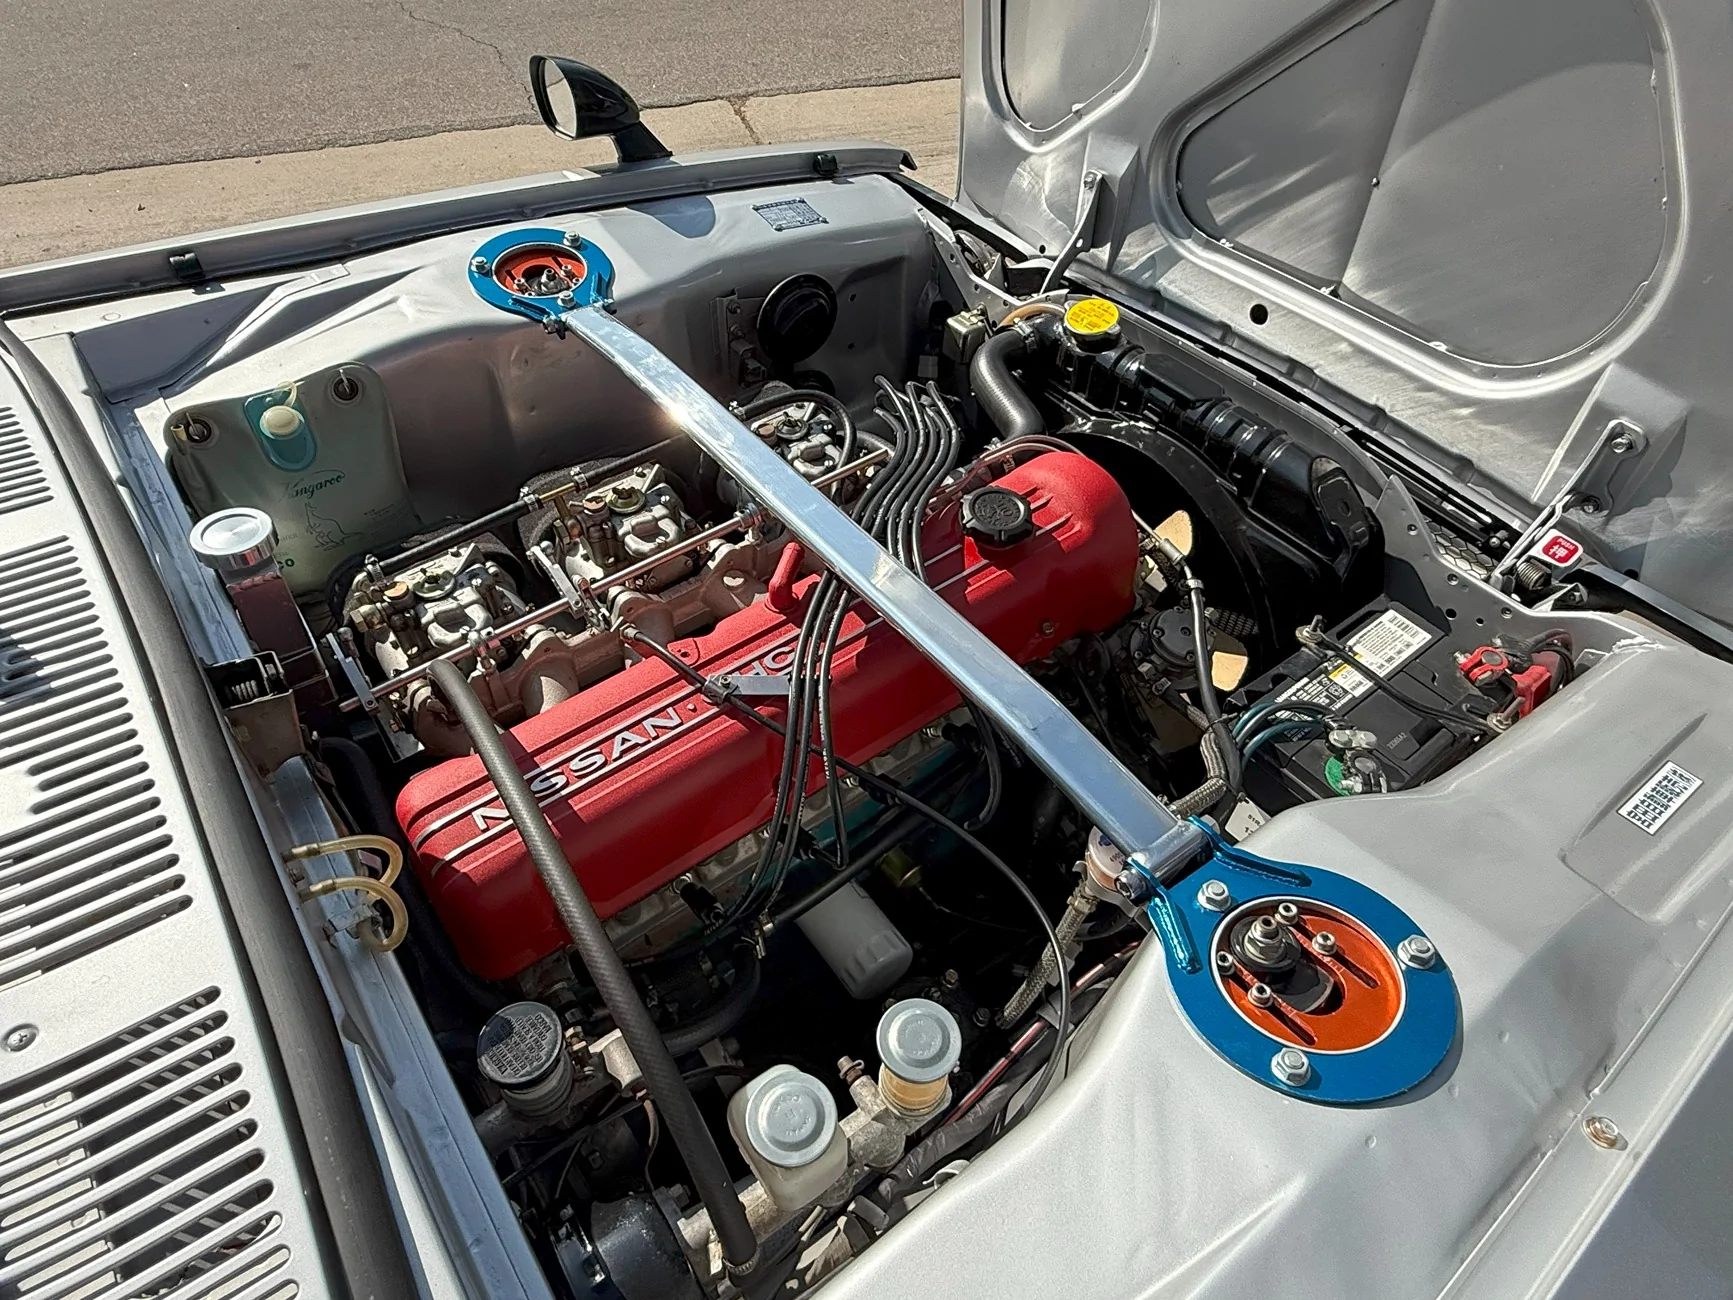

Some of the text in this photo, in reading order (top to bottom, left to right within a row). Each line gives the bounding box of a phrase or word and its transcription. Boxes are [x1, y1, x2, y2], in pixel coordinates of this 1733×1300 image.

[1548, 544, 1568, 559] 押
[1557, 538, 1574, 550] PUSH
[472, 707, 683, 830] NSSAN
